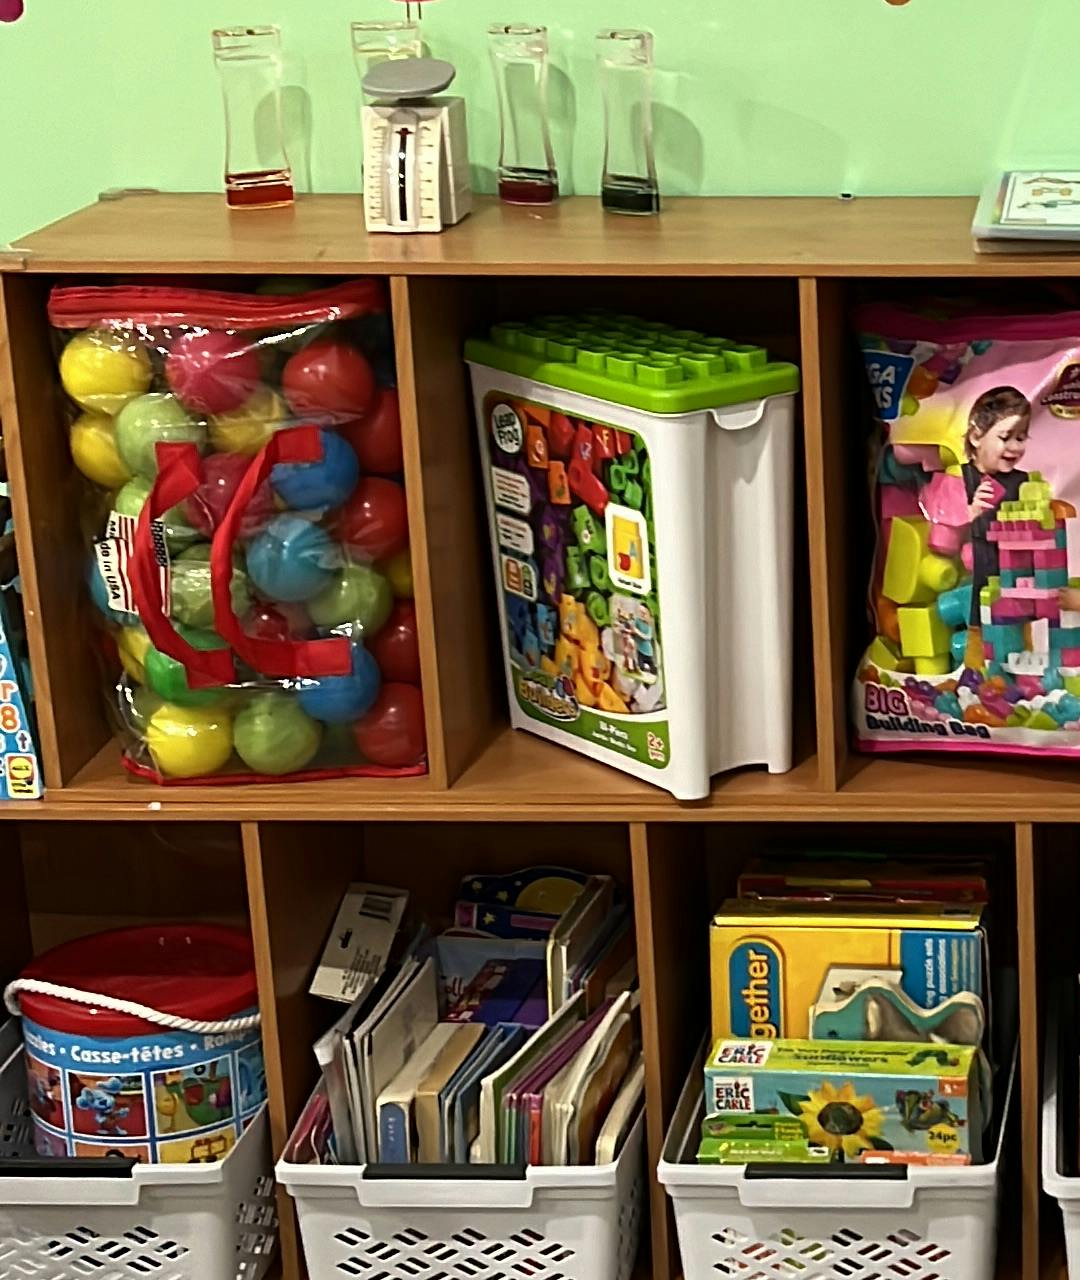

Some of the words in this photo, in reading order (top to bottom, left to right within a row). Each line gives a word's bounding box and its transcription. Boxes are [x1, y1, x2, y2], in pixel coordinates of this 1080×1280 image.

[103, 561, 112, 571] in
[106, 575, 121, 599] USA
[865, 684, 908, 715] BIG
[866, 714, 949, 736] Building
[741, 949, 778, 1039] gether
[70, 1043, 184, 1064] Casse-têtes
[718, 1054, 763, 1065] CARLE
[715, 1083, 750, 1099] ERIC
[715, 1099, 752, 1111] CARLE
[928, 1129, 957, 1144] 24pc
